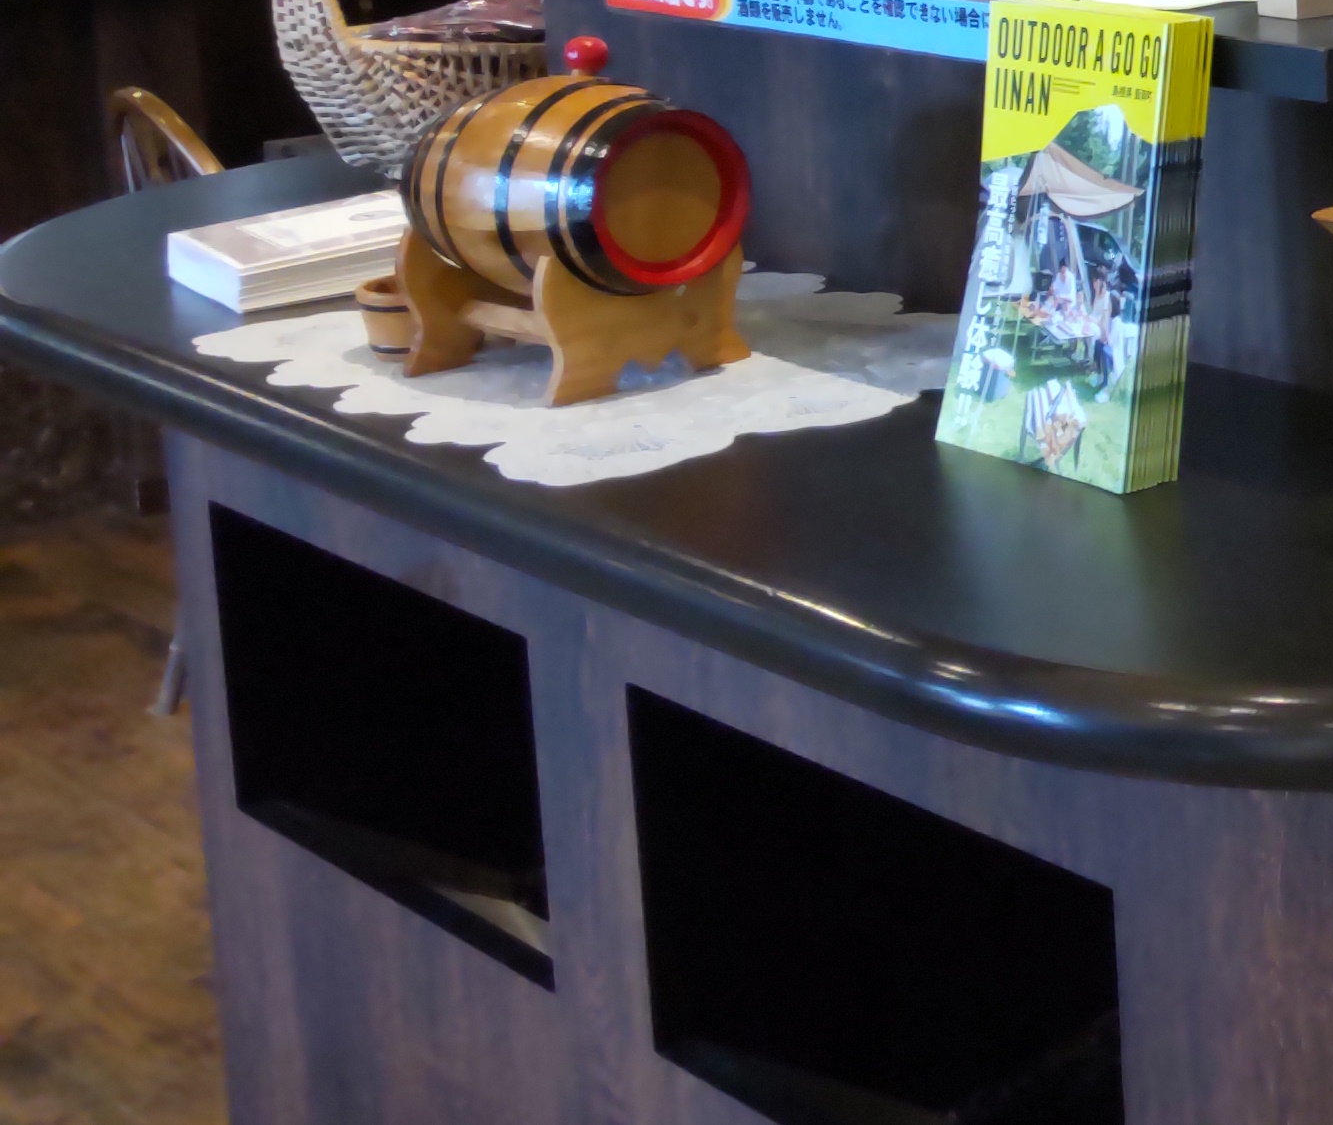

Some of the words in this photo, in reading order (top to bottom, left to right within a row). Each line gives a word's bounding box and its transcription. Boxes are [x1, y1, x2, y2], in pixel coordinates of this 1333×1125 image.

[998, 17, 1088, 69] OUTDOOR
[1093, 29, 1104, 72] A
[1111, 31, 1134, 76] GO
[1140, 35, 1162, 80] GO
[994, 67, 1051, 116] IINAN
